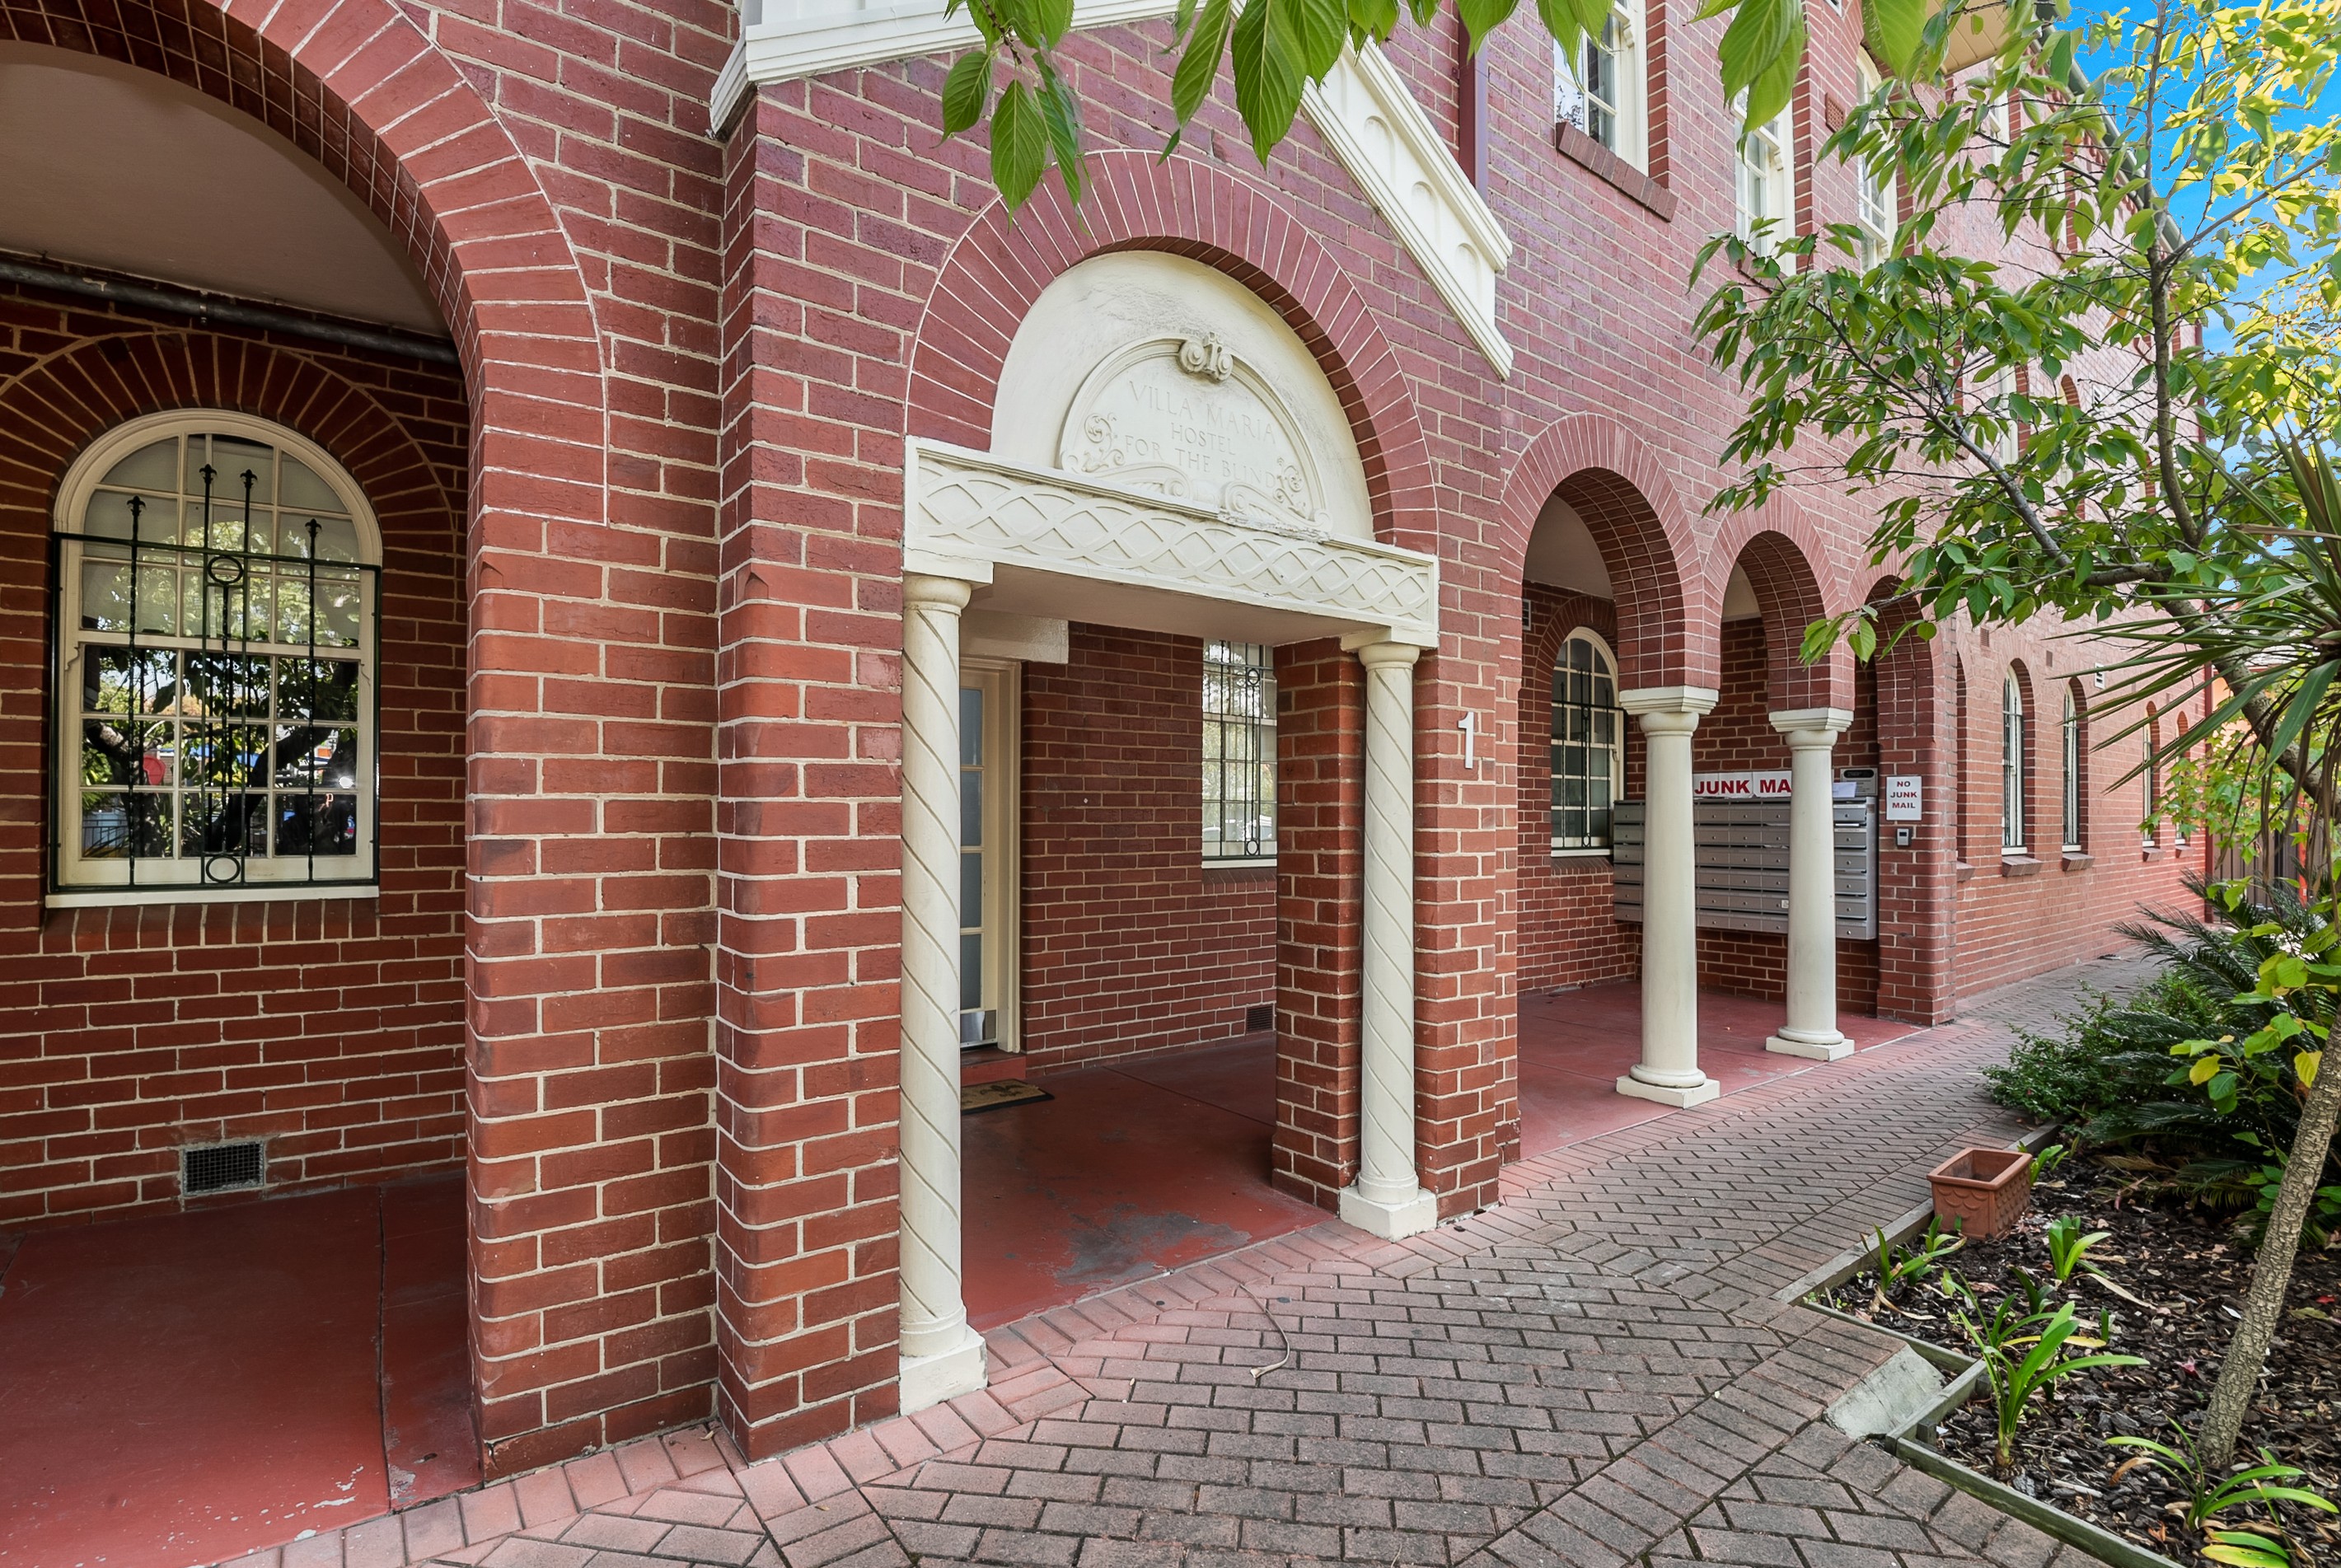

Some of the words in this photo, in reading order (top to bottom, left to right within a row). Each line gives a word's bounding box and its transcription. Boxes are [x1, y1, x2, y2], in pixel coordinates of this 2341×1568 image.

[1129, 381, 1194, 421] VILLA
[1206, 403, 1276, 445] MARIA
[1170, 422, 1236, 456] HOSTEL
[1125, 434, 1164, 462] FOR
[1174, 447, 1211, 474] THE
[1221, 460, 1278, 489] BLIND
[1458, 711, 1475, 770] 1
[1694, 779, 1750, 795] JUNK
[1759, 779, 1792, 793] MA
